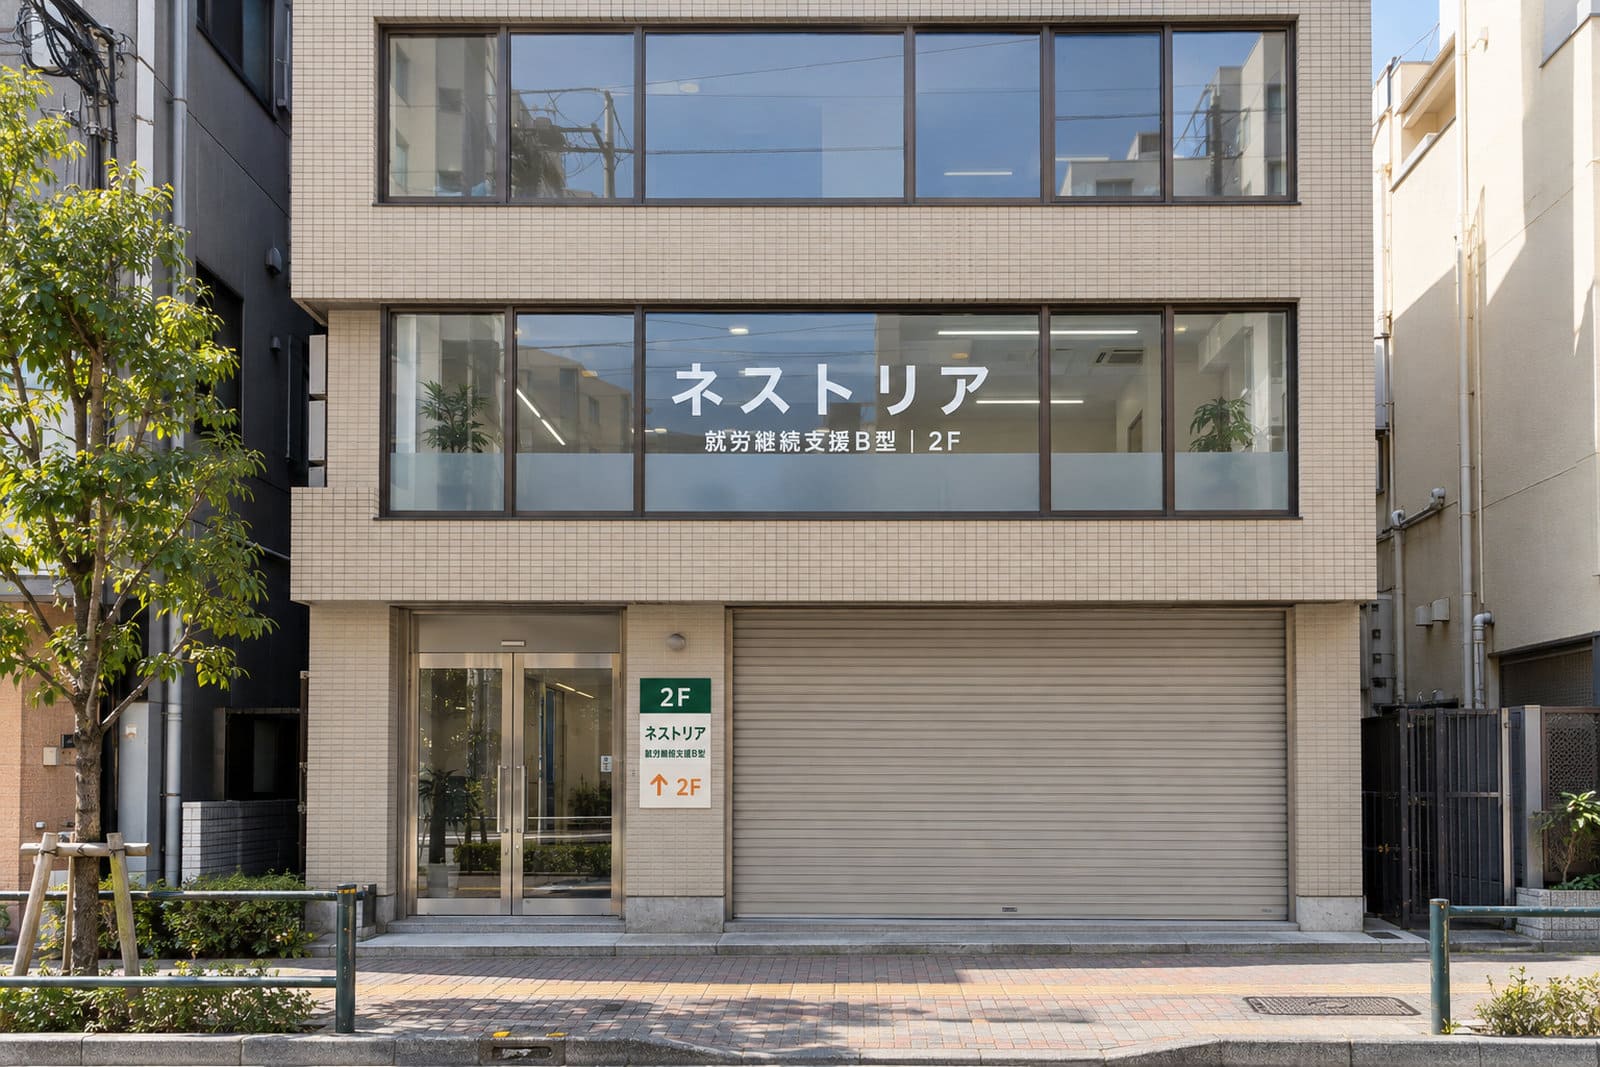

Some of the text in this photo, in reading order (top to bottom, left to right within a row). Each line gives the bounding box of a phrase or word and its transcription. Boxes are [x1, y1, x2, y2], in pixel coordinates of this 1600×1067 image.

[671, 363, 989, 416] ネストリア
[704, 429, 897, 453] 就労継続支援B型
[928, 431, 961, 451] 2F
[660, 687, 691, 707] 2F
[645, 726, 706, 741] ネストリア
[676, 777, 702, 797] 2F
